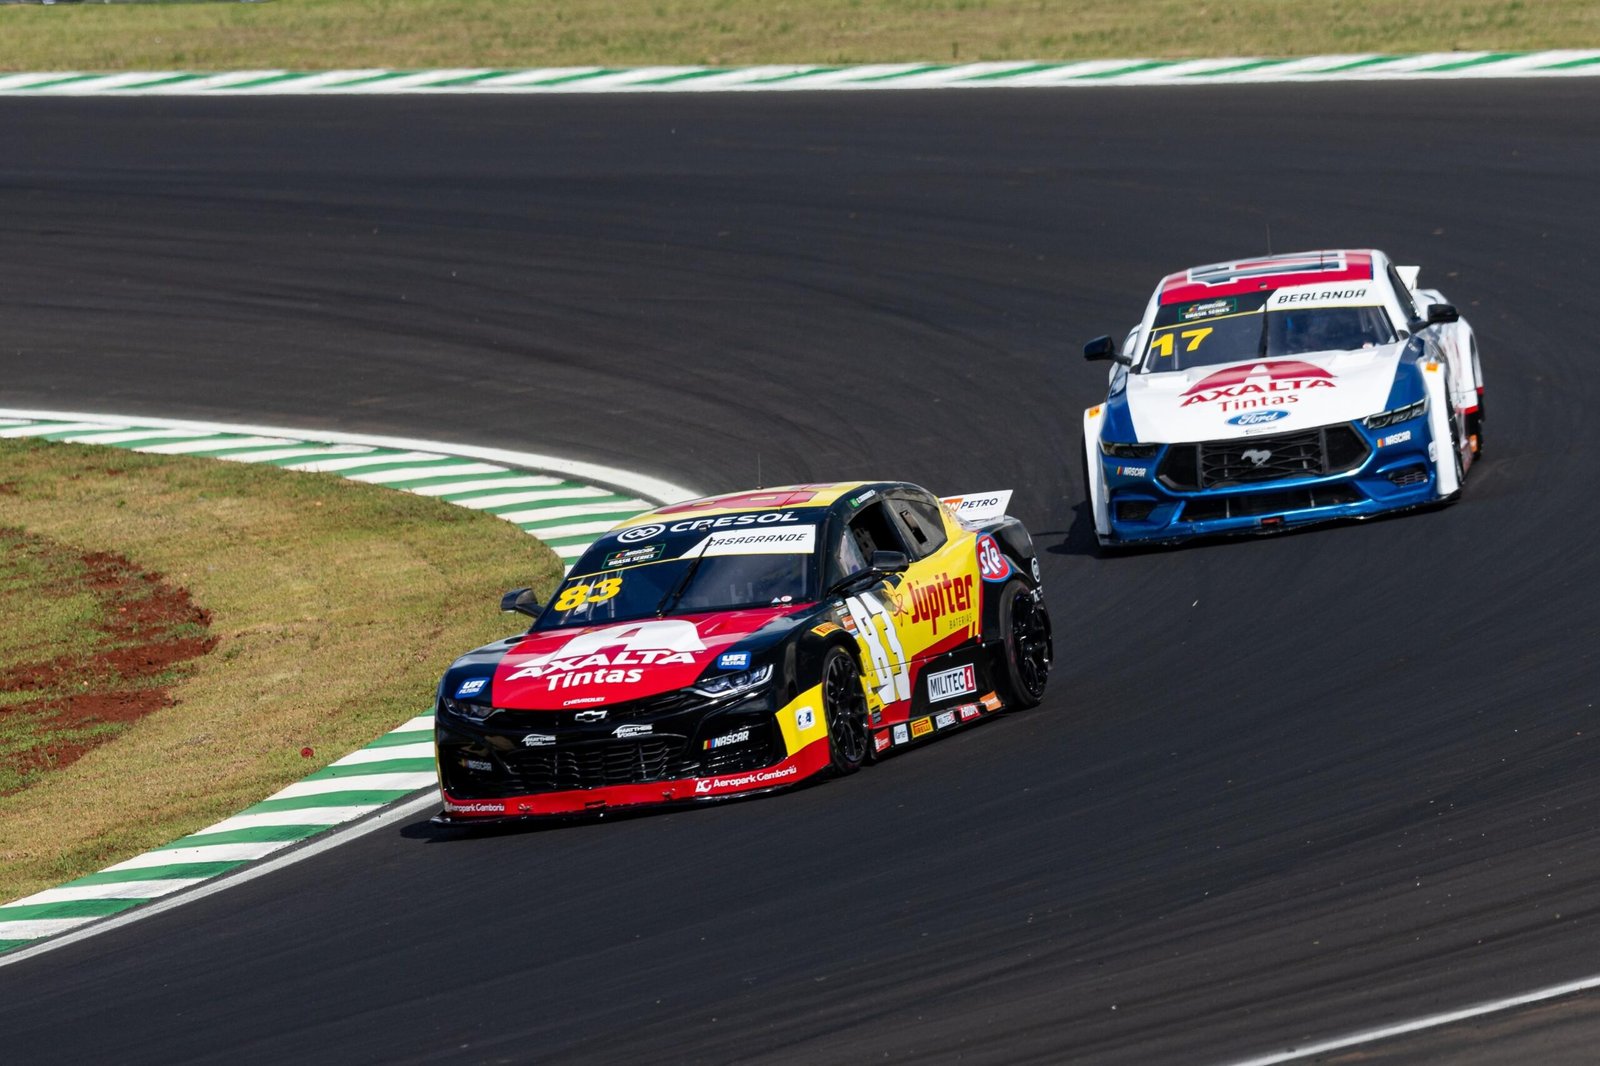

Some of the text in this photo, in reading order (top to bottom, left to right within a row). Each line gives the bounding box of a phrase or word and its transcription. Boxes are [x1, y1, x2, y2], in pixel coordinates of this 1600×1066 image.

[1278, 288, 1367, 304] BERLANDA
[1151, 327, 1214, 357] 17
[1180, 379, 1337, 408] AXALTA
[1217, 394, 1299, 412] Tintas
[1237, 411, 1279, 426] Ford
[1385, 431, 1411, 446] NASCAR
[1123, 466, 1147, 478] NASCAR
[961, 498, 998, 509] PETRO
[670, 512, 799, 532] CRESOL
[708, 533, 807, 547] CASAGRANDE
[980, 539, 1002, 575] STP
[554, 577, 623, 611] 83
[505, 649, 696, 681] AXALTA
[722, 653, 747, 662] UFI
[462, 680, 486, 689] UFI
[547, 668, 644, 691] Tintas
[930, 672, 965, 698] MILITEC
[563, 696, 605, 706] CHEVROLET
[714, 731, 749, 747] NASCAR
[467, 760, 492, 771] NASCAR
[713, 775, 756, 788] Aeropark
